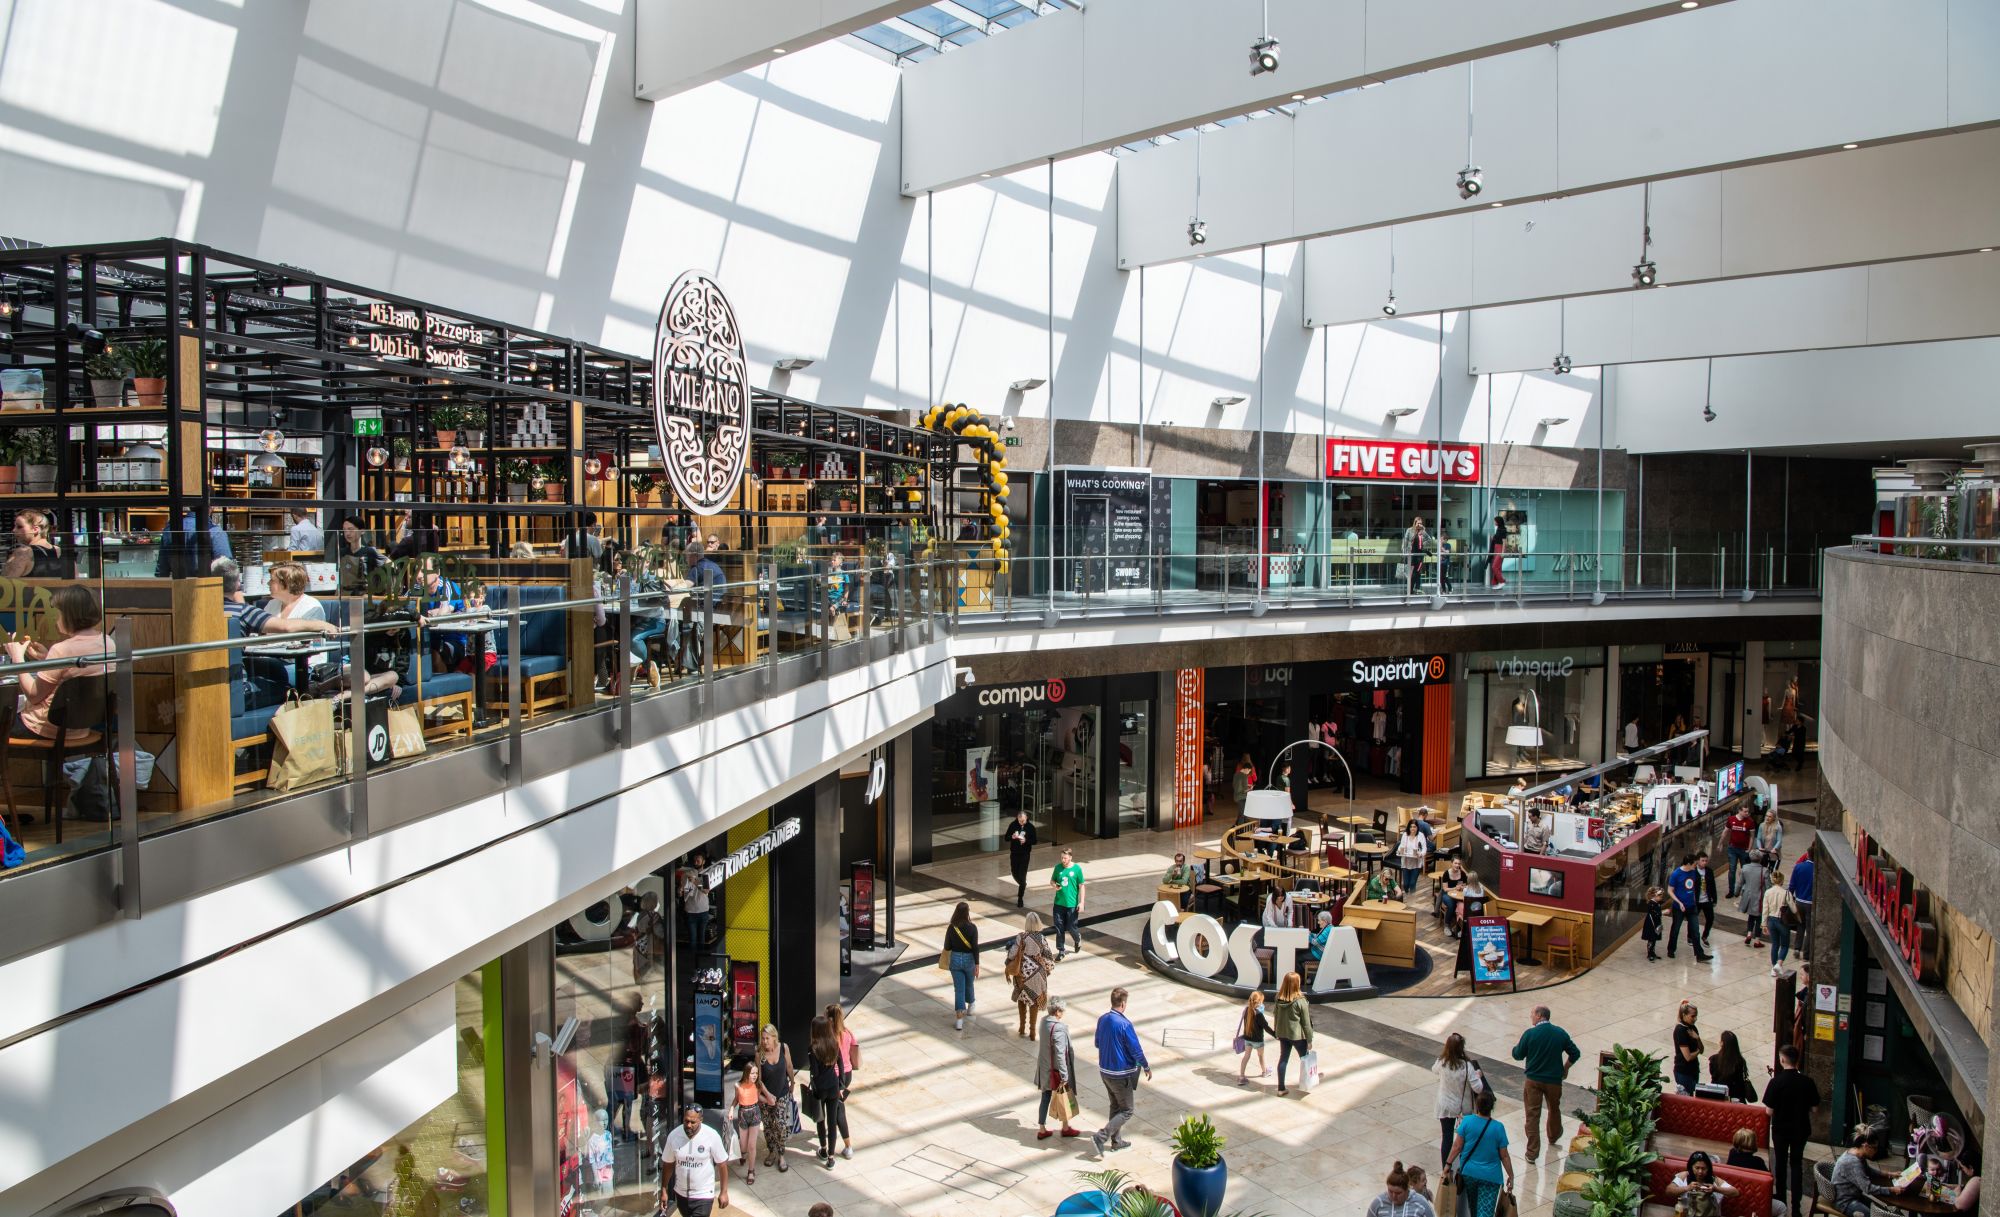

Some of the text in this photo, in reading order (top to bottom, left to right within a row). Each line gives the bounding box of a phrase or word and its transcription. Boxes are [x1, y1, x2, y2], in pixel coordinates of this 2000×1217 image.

[370, 303, 483, 345] Milano Pizzeria
[370, 333, 470, 369] Dublin Swords
[667, 370, 740, 417] MILANO
[1333, 444, 1475, 477] FIVE GUYS
[1067, 479, 1145, 490] WHAT'S COOKING?
[372, 731, 386, 755] JD
[865, 758, 886, 805] JD
[725, 817, 801, 880] KING OF TRAINERS
[1061, 876, 1069, 887] 3
[1150, 900, 1372, 993] COSTA
[699, 998, 710, 1006] AM
